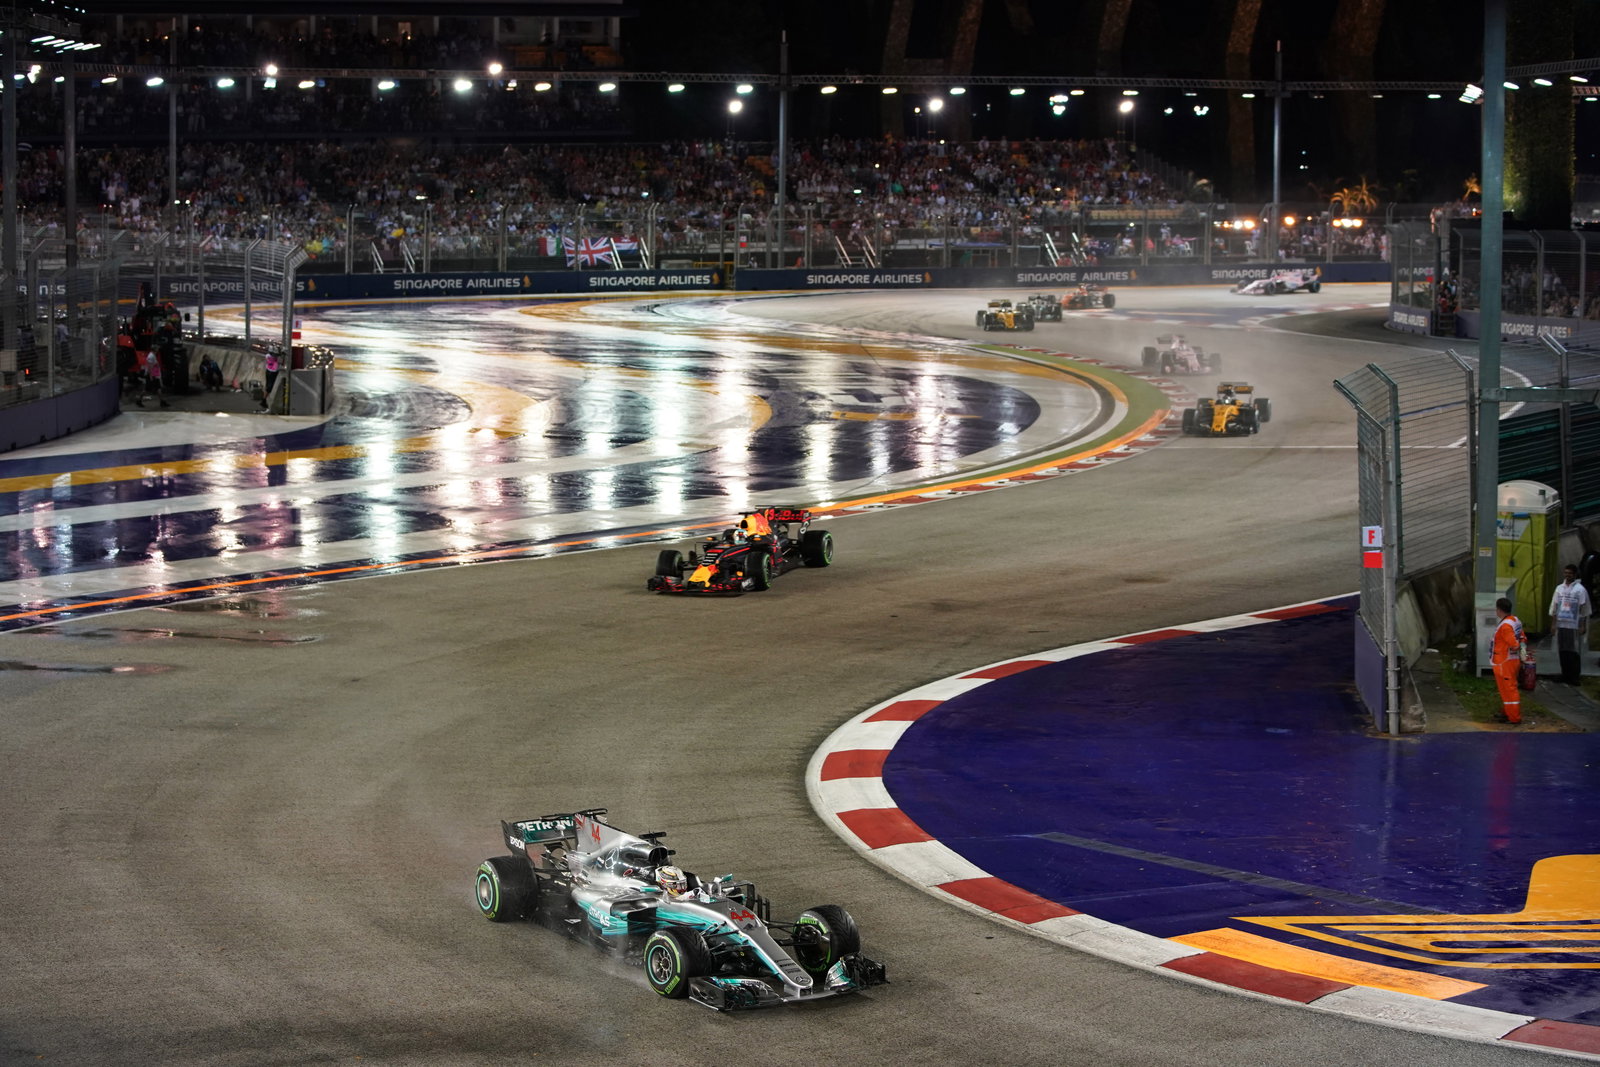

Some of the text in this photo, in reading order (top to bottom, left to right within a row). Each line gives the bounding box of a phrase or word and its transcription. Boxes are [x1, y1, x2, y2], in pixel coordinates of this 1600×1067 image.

[806, 273, 923, 284] SINGAPORE AIRLINES
[1017, 271, 1128, 282] SINGAPORE AIRLINES
[1212, 269, 1267, 279] SINGAPORE
[250, 281, 305, 292] AIRLIS
[393, 278, 521, 290] SINGAPORE AIRLINES
[589, 275, 711, 287] SINGAPORE AIRLINES
[1500, 322, 1535, 336] INGAPORE
[1368, 530, 1375, 544] F
[731, 910, 755, 921] 44
